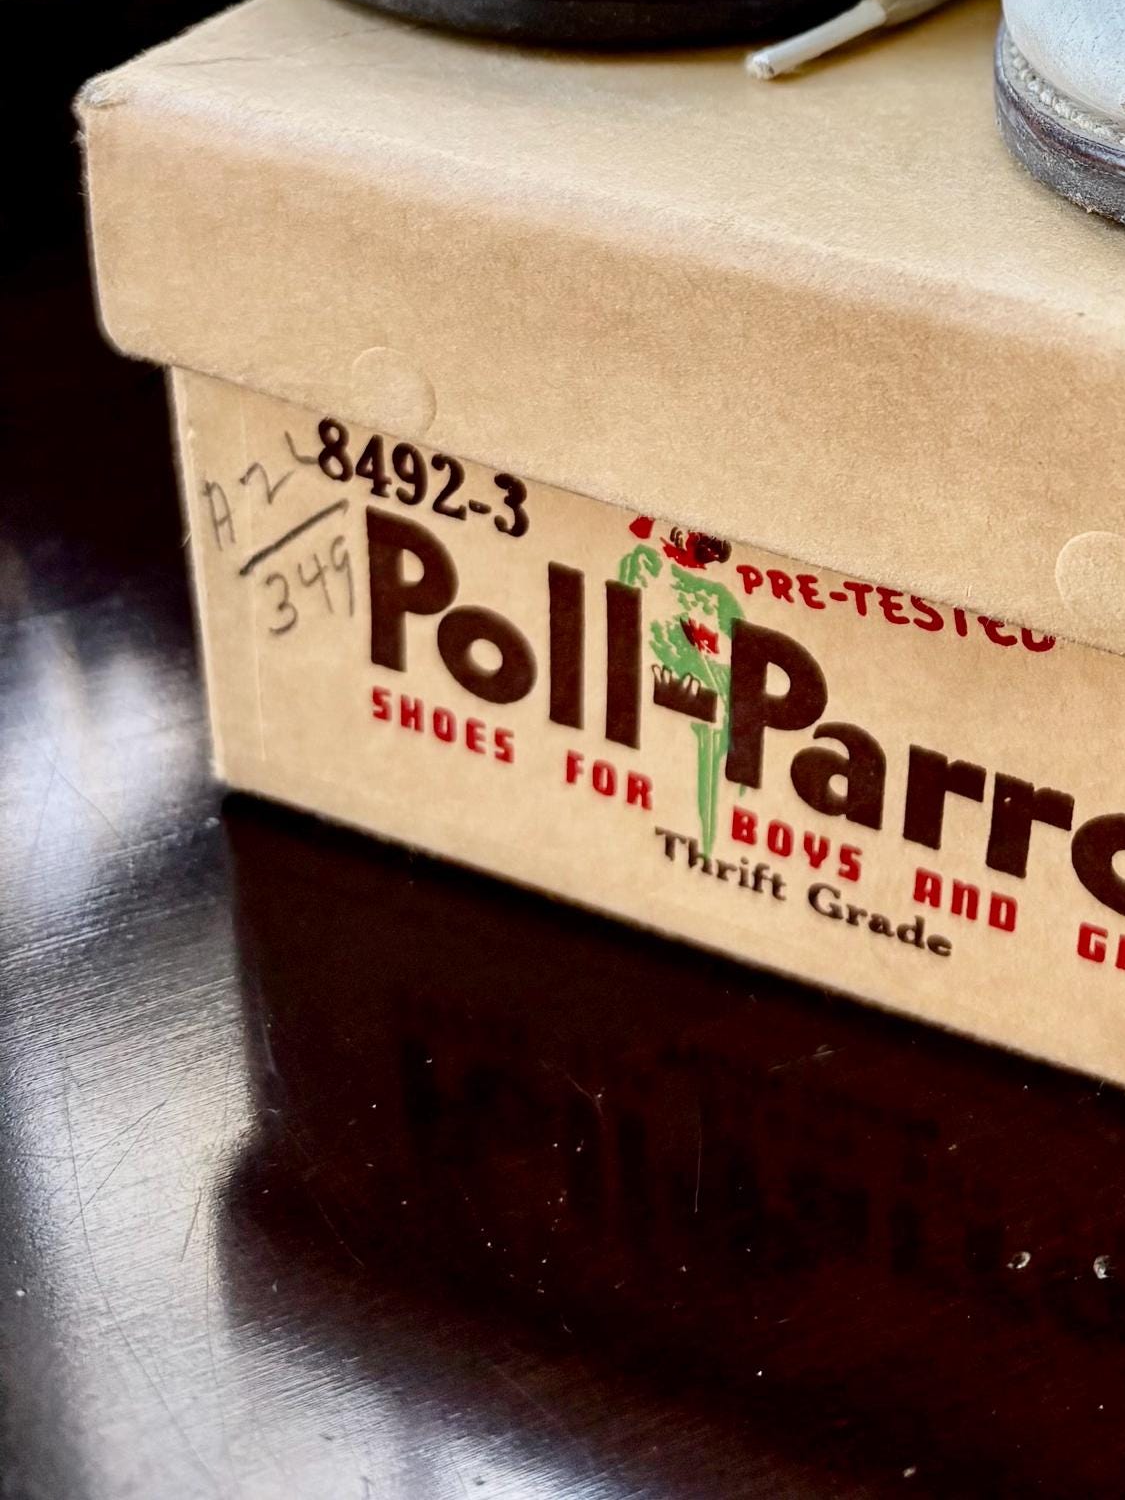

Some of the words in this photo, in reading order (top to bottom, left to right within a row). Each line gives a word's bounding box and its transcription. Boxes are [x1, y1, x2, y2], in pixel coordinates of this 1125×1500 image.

[318, 416, 530, 537] 8492-3
[371, 686, 516, 763] SHOES
[564, 750, 654, 811] FOR
[730, 806, 863, 884] BOYS
[913, 870, 1019, 934] AND
[654, 826, 788, 902] Thrift
[808, 883, 953, 958] Grade
